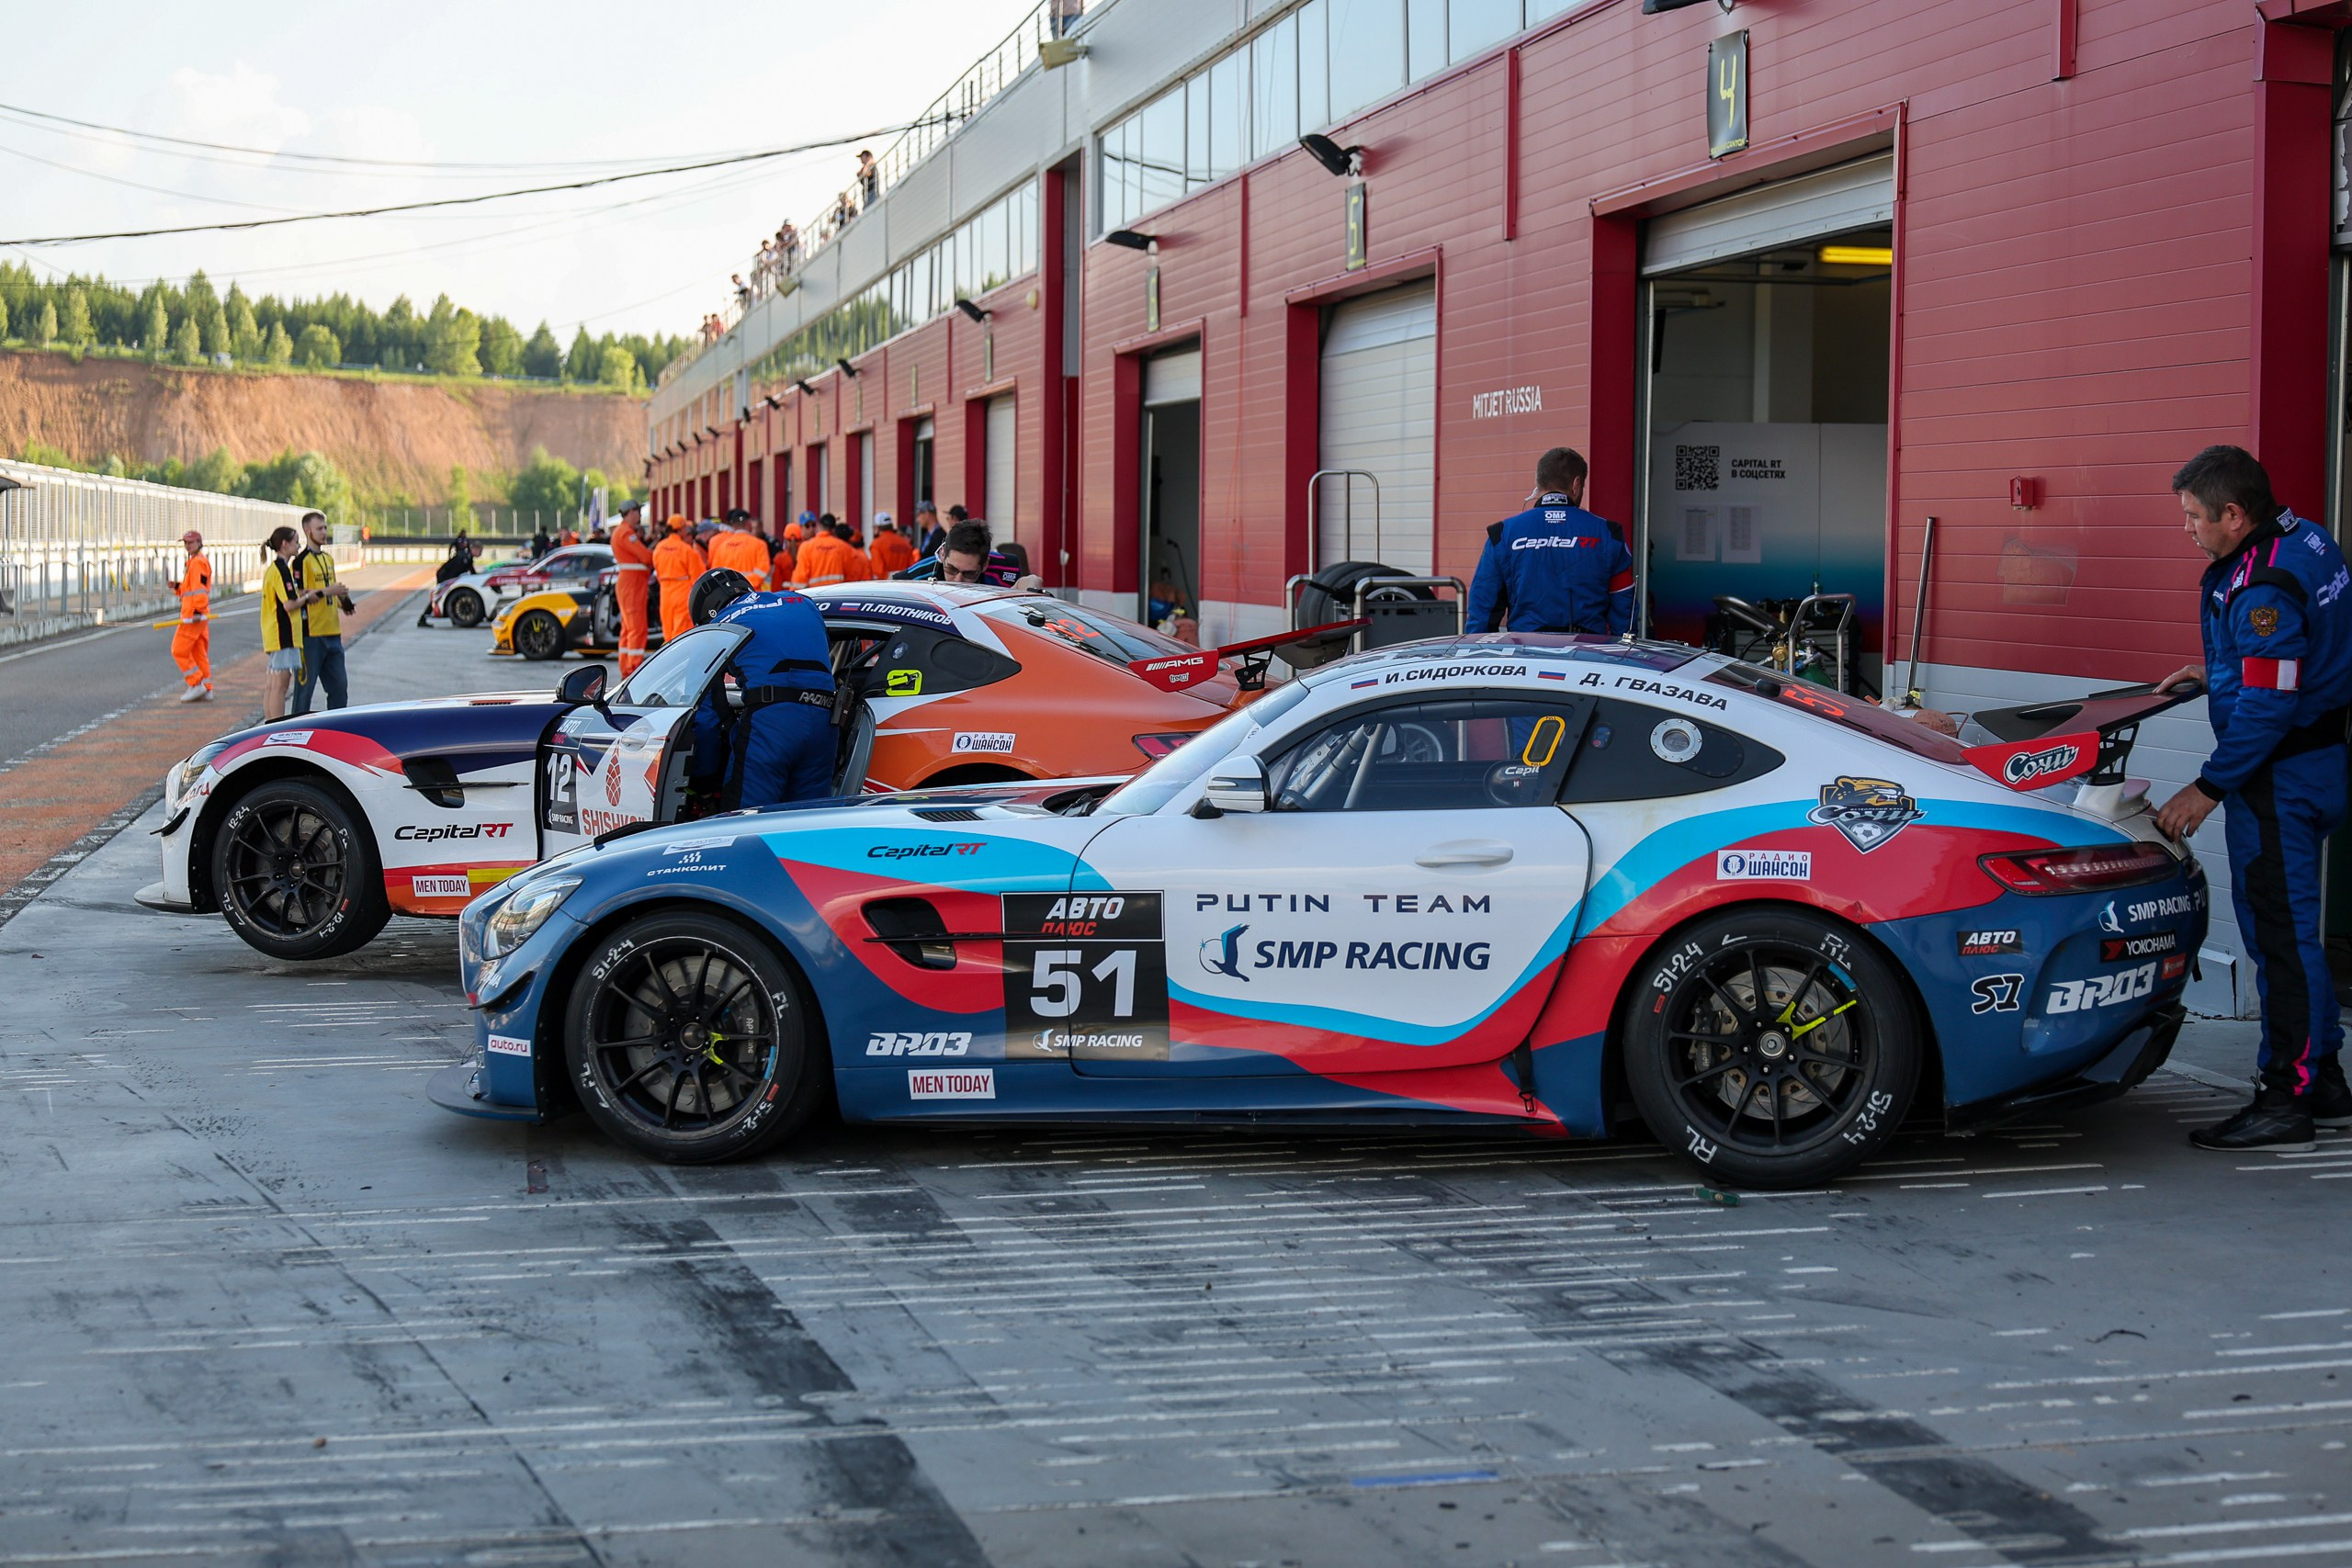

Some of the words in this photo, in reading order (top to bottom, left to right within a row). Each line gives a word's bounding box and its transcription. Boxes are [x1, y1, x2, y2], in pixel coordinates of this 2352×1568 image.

[1720, 53, 1737, 129] 4
[1349, 195, 1360, 256] 5
[1473, 390, 1505, 419] MITJET
[1505, 385, 1543, 414] RUSSIA
[1731, 459, 1769, 468] CAPITAL
[1770, 459, 1782, 468] RT
[1739, 469, 1786, 480] СОЦСЕТЯХ
[860, 603, 954, 626] П.ПЛОТНИКОВ
[1385, 665, 1527, 684] И.СИДОРКОВА
[1578, 672, 1605, 687] Д.
[1614, 676, 1728, 711] ГВАЗАВА
[971, 739, 1012, 751] ШАНСОН
[547, 752, 572, 803] 12
[1748, 852, 1808, 862] РАДИО
[647, 864, 728, 877] СТАНКОЛИТ
[1748, 861, 1808, 877] ШАНСОН
[415, 880, 436, 894] MEN
[437, 879, 467, 893] TODAY
[1045, 897, 1125, 919] АВТО
[1196, 893, 1330, 913] PUTIN
[1363, 894, 1491, 914] TEAM
[2127, 900, 2158, 922] SMP
[2157, 895, 2191, 917] RACING
[1041, 921, 1098, 936] ПЛЮС
[1964, 931, 2017, 945] АВТО
[1253, 939, 1338, 970] SMP
[1344, 940, 1491, 971] RACING
[1962, 945, 2000, 954] ПЛЮС
[2125, 933, 2177, 956] YOKOHAMA
[591, 939, 636, 980] 51-2-4
[1653, 942, 1704, 993] 51-2-4
[1030, 950, 1137, 1018] 51
[490, 1039, 528, 1053] auto.ru
[1054, 1034, 1086, 1047] SMP
[1087, 1035, 1143, 1047] RACING
[912, 1076, 944, 1093] MEN
[946, 1075, 990, 1093] TODAY
[1842, 1090, 1894, 1145] 51-2-4
[1686, 1125, 1719, 1164] RL
